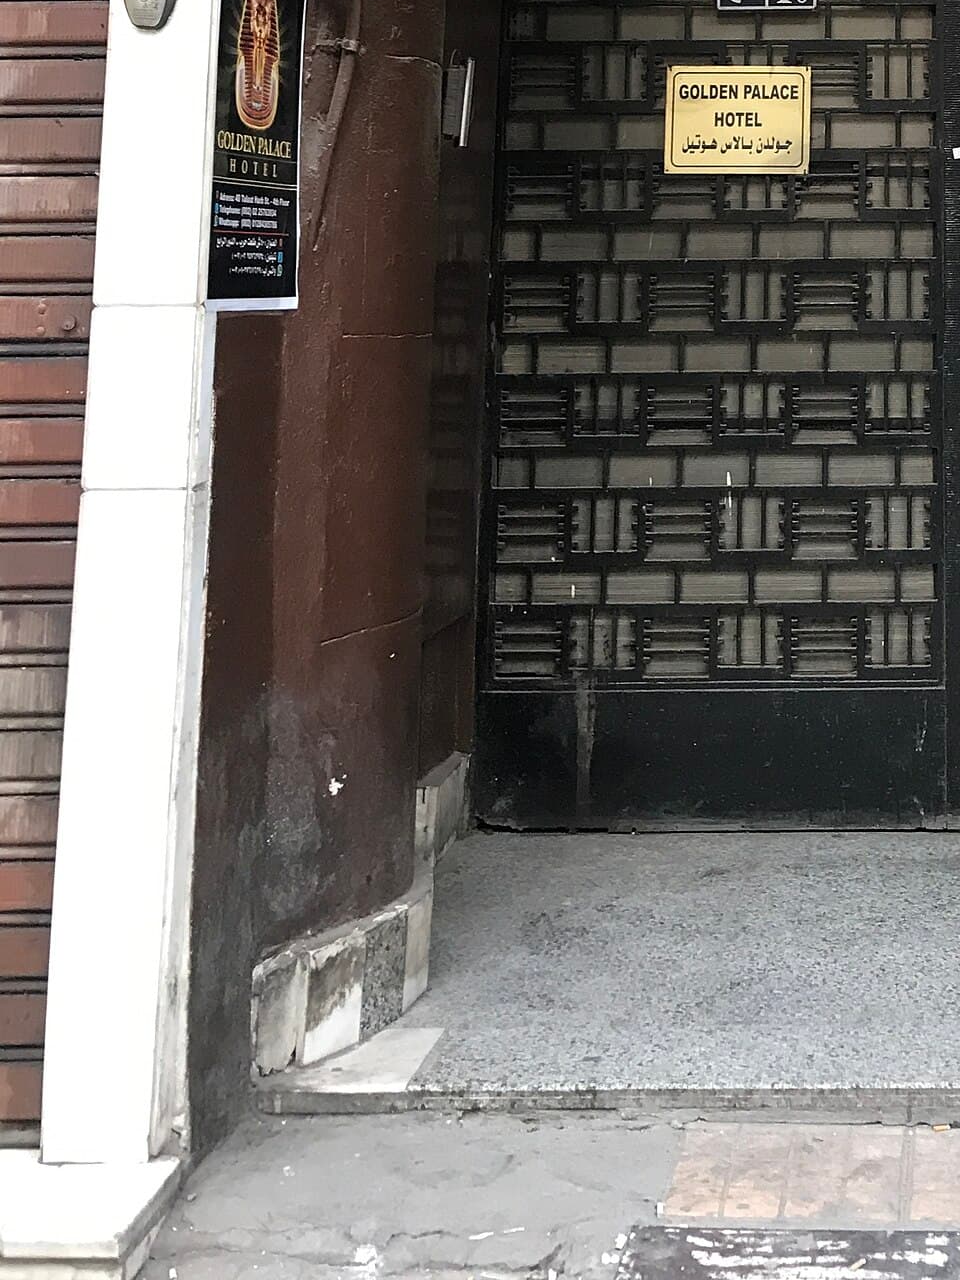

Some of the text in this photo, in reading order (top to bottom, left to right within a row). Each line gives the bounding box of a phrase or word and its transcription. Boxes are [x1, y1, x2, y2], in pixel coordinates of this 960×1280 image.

[679, 84, 799, 100] GOLDEN PALACE
[714, 111, 762, 127] HOTEL
[217, 130, 292, 159] GOLDEN PALACE
[682, 134, 793, 154] جولدن بالاس هوتيل
[229, 158, 278, 178] HOTEL
